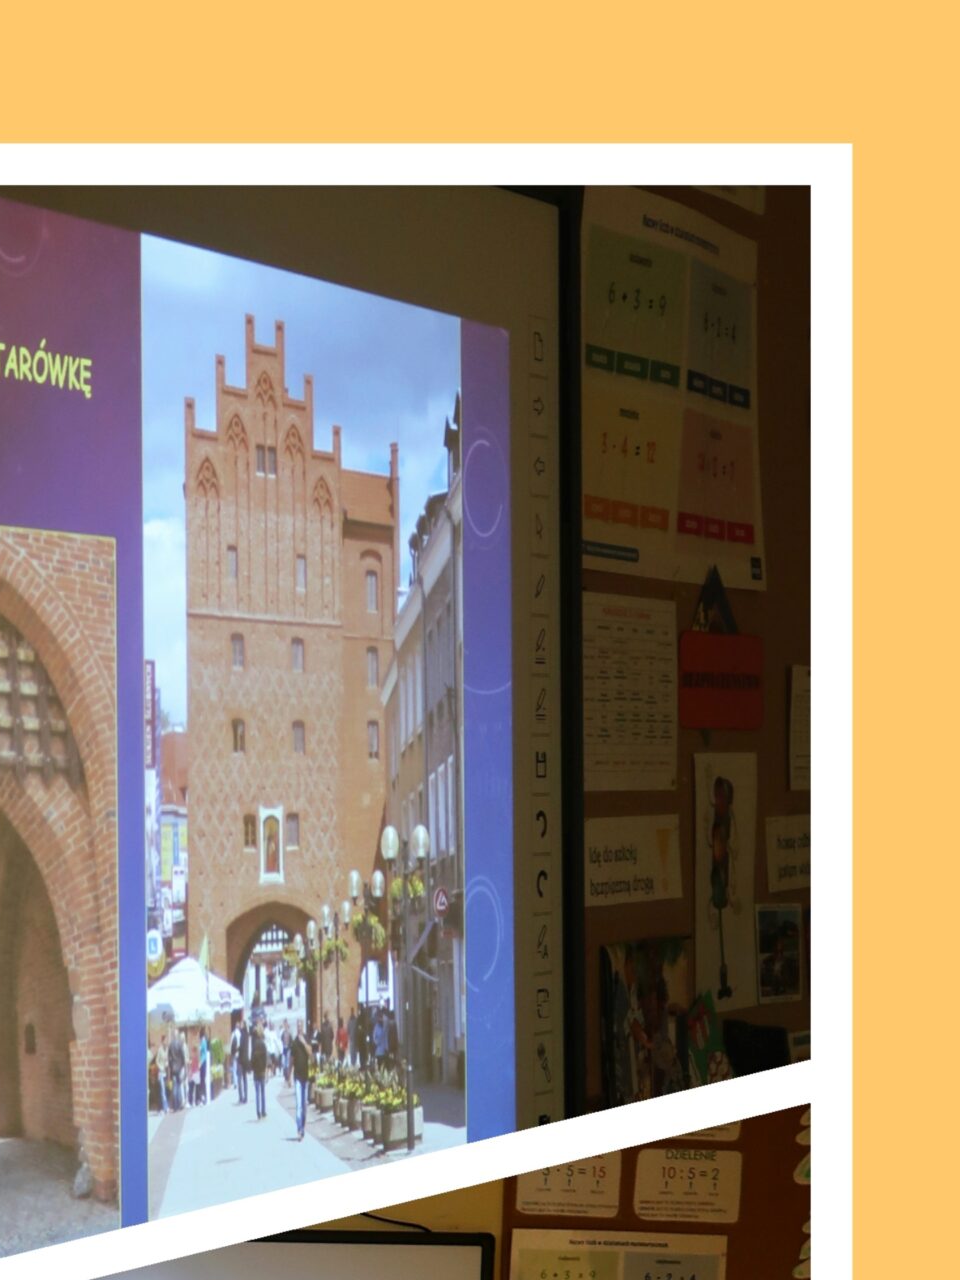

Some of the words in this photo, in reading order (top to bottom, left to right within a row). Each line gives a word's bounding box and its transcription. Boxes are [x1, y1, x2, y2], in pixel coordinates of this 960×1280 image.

[665, 1149, 717, 1161] DZIELENIE
[566, 1164, 574, 1177] 5
[592, 1165, 607, 1178] 15
[661, 1166, 676, 1180] 10
[687, 1167, 696, 1180] 5
[711, 1168, 720, 1181] 2
